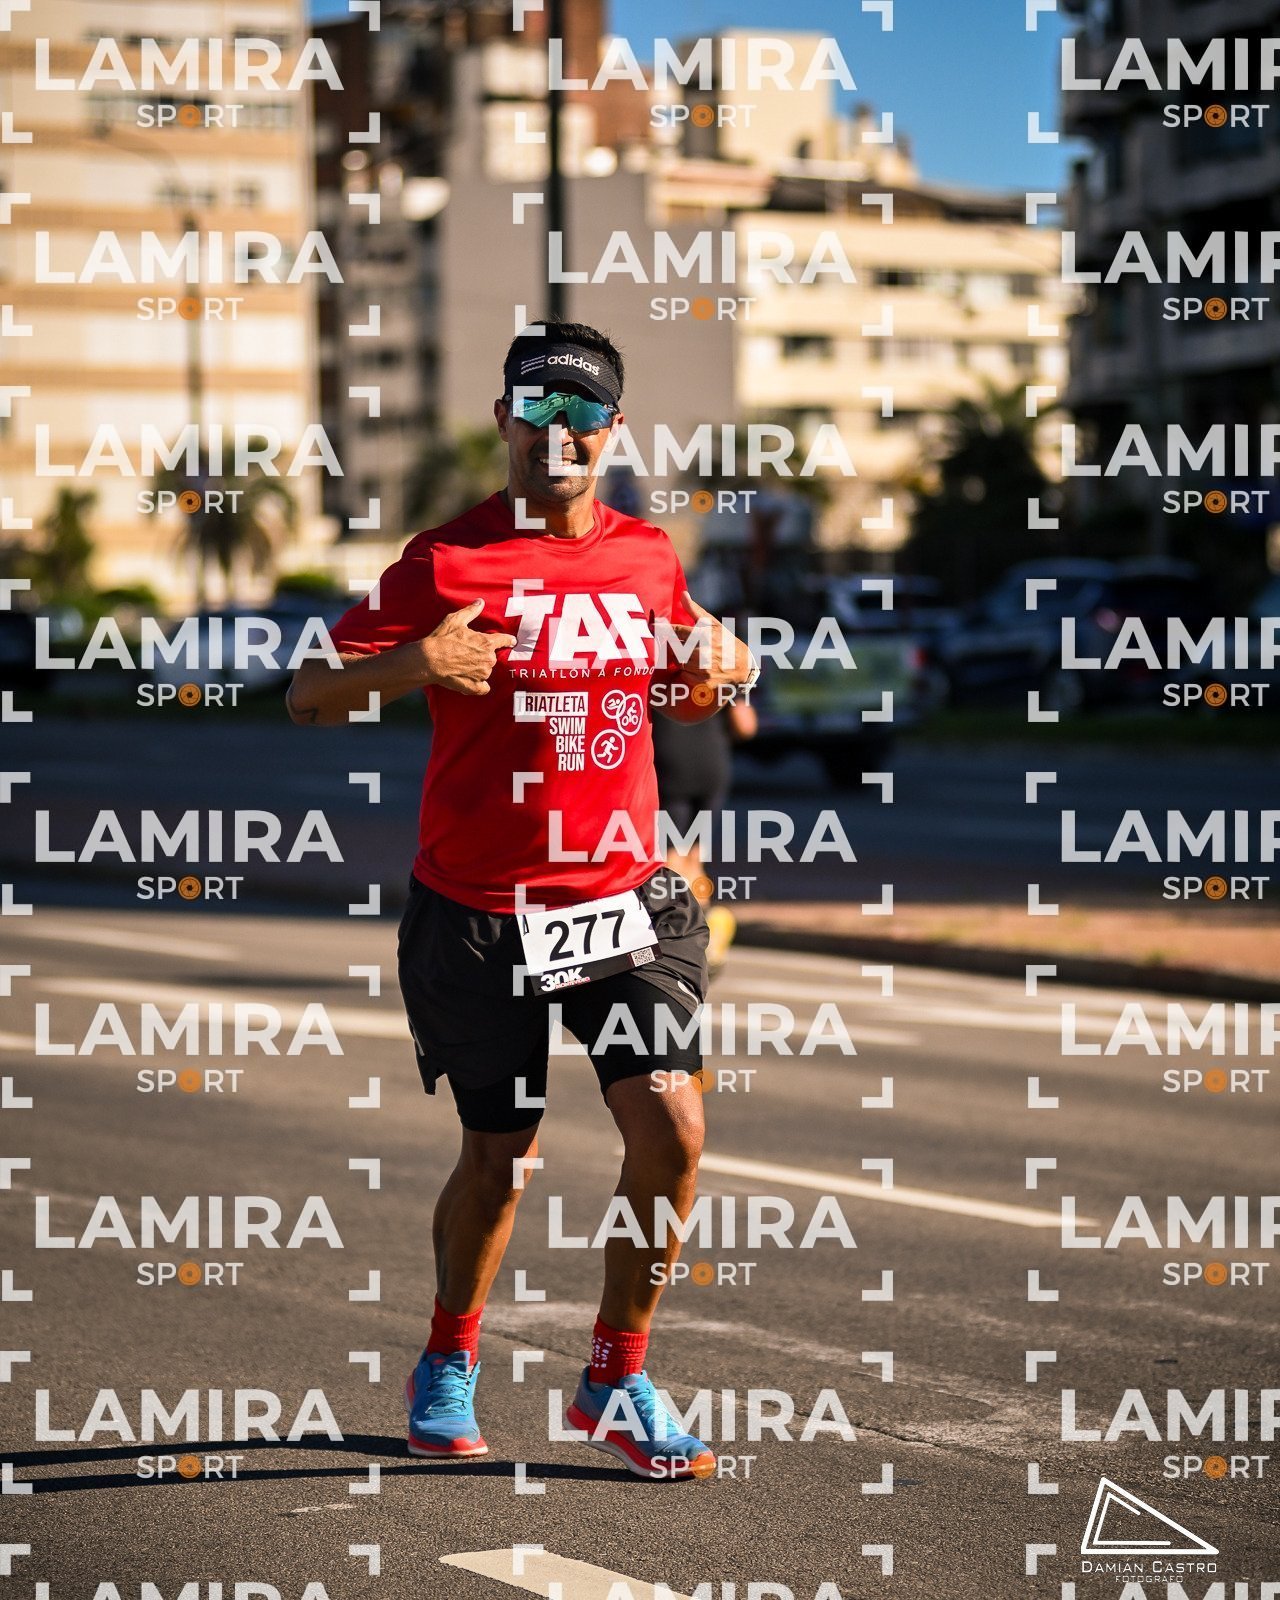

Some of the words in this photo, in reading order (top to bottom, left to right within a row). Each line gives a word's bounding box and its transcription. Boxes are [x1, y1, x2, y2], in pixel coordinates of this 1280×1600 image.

[547, 353, 600, 376] adidas
[504, 593, 654, 661] TAF
[509, 667, 591, 679] TRIATLÓN
[598, 668, 606, 677] A
[613, 665, 655, 677] FONDO
[516, 695, 586, 712] TRIATLETA
[549, 717, 586, 735] SWIM
[555, 735, 586, 753] BIKE
[557, 753, 585, 771] RUN
[544, 909, 626, 962] 277
[540, 966, 583, 992] 30K
